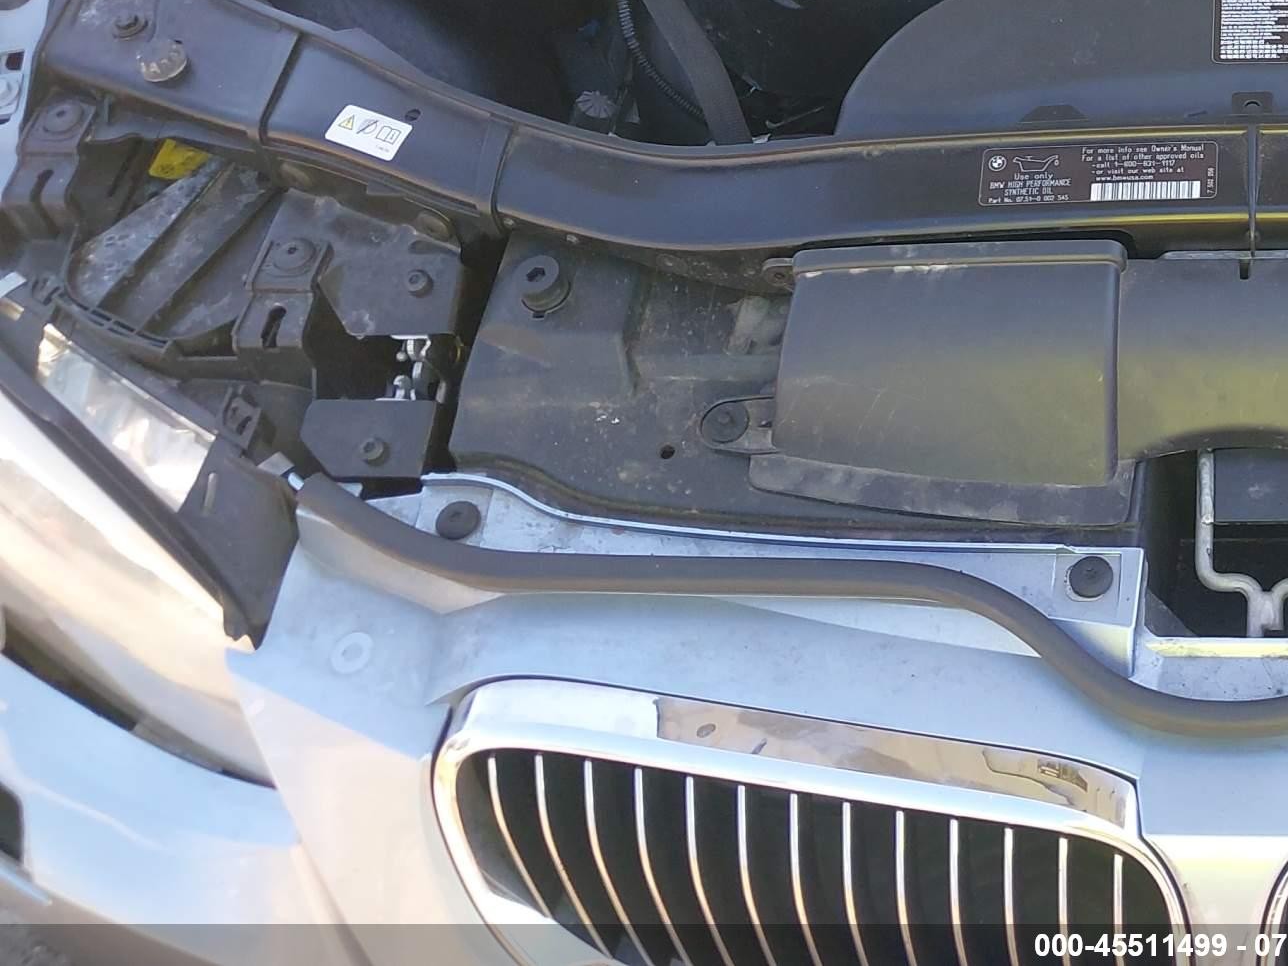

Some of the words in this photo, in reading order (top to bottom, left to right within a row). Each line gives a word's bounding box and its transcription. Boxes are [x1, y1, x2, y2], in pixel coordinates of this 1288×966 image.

[1081, 146, 1094, 154] For
[1118, 145, 1132, 153] info
[1151, 144, 1177, 152] Owner's
[1181, 143, 1204, 151] Manual
[1081, 154, 1094, 162] For
[1105, 153, 1118, 161] list
[1122, 153, 1130, 161] of
[1156, 152, 1187, 160] approved
[1034, 172, 1053, 180] only
[989, 181, 1005, 190] BMW
[1008, 180, 1024, 188] HIGH
[1026, 178, 1072, 187] PERFORMANCE
[1004, 188, 1039, 196] SYNTHETIC
